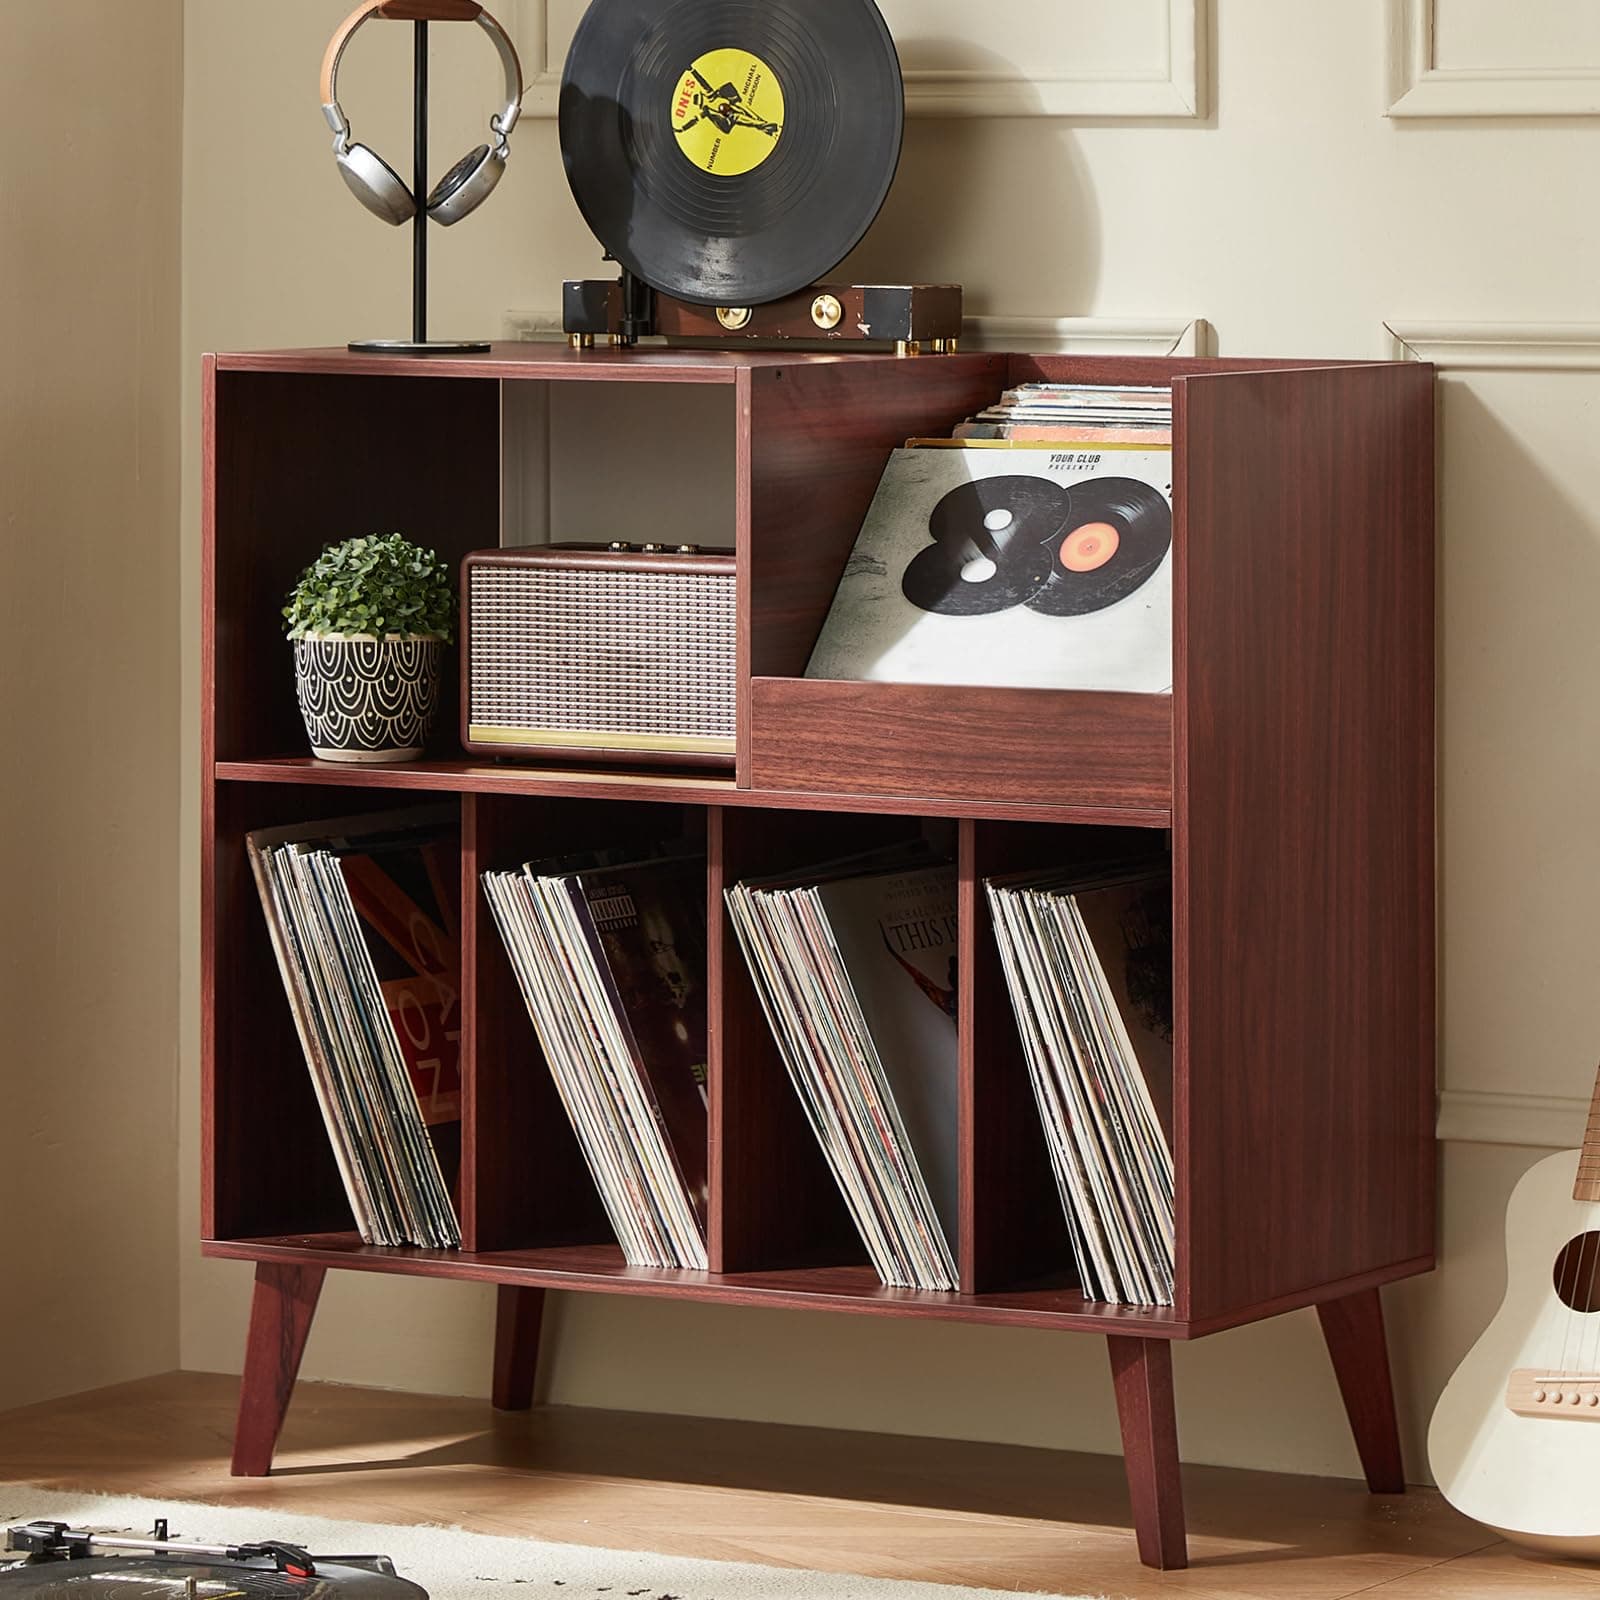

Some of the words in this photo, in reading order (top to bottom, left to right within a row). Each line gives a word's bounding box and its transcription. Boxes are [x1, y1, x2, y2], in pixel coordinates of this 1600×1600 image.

[742, 64, 757, 95] MICHAEL
[748, 74, 761, 106] JACKSON
[675, 79, 695, 118] ONES
[706, 138, 721, 170] NUMBER
[1050, 454, 1074, 463] YOUR
[1077, 454, 1101, 463] CLUB
[889, 920, 944, 952] THIS
